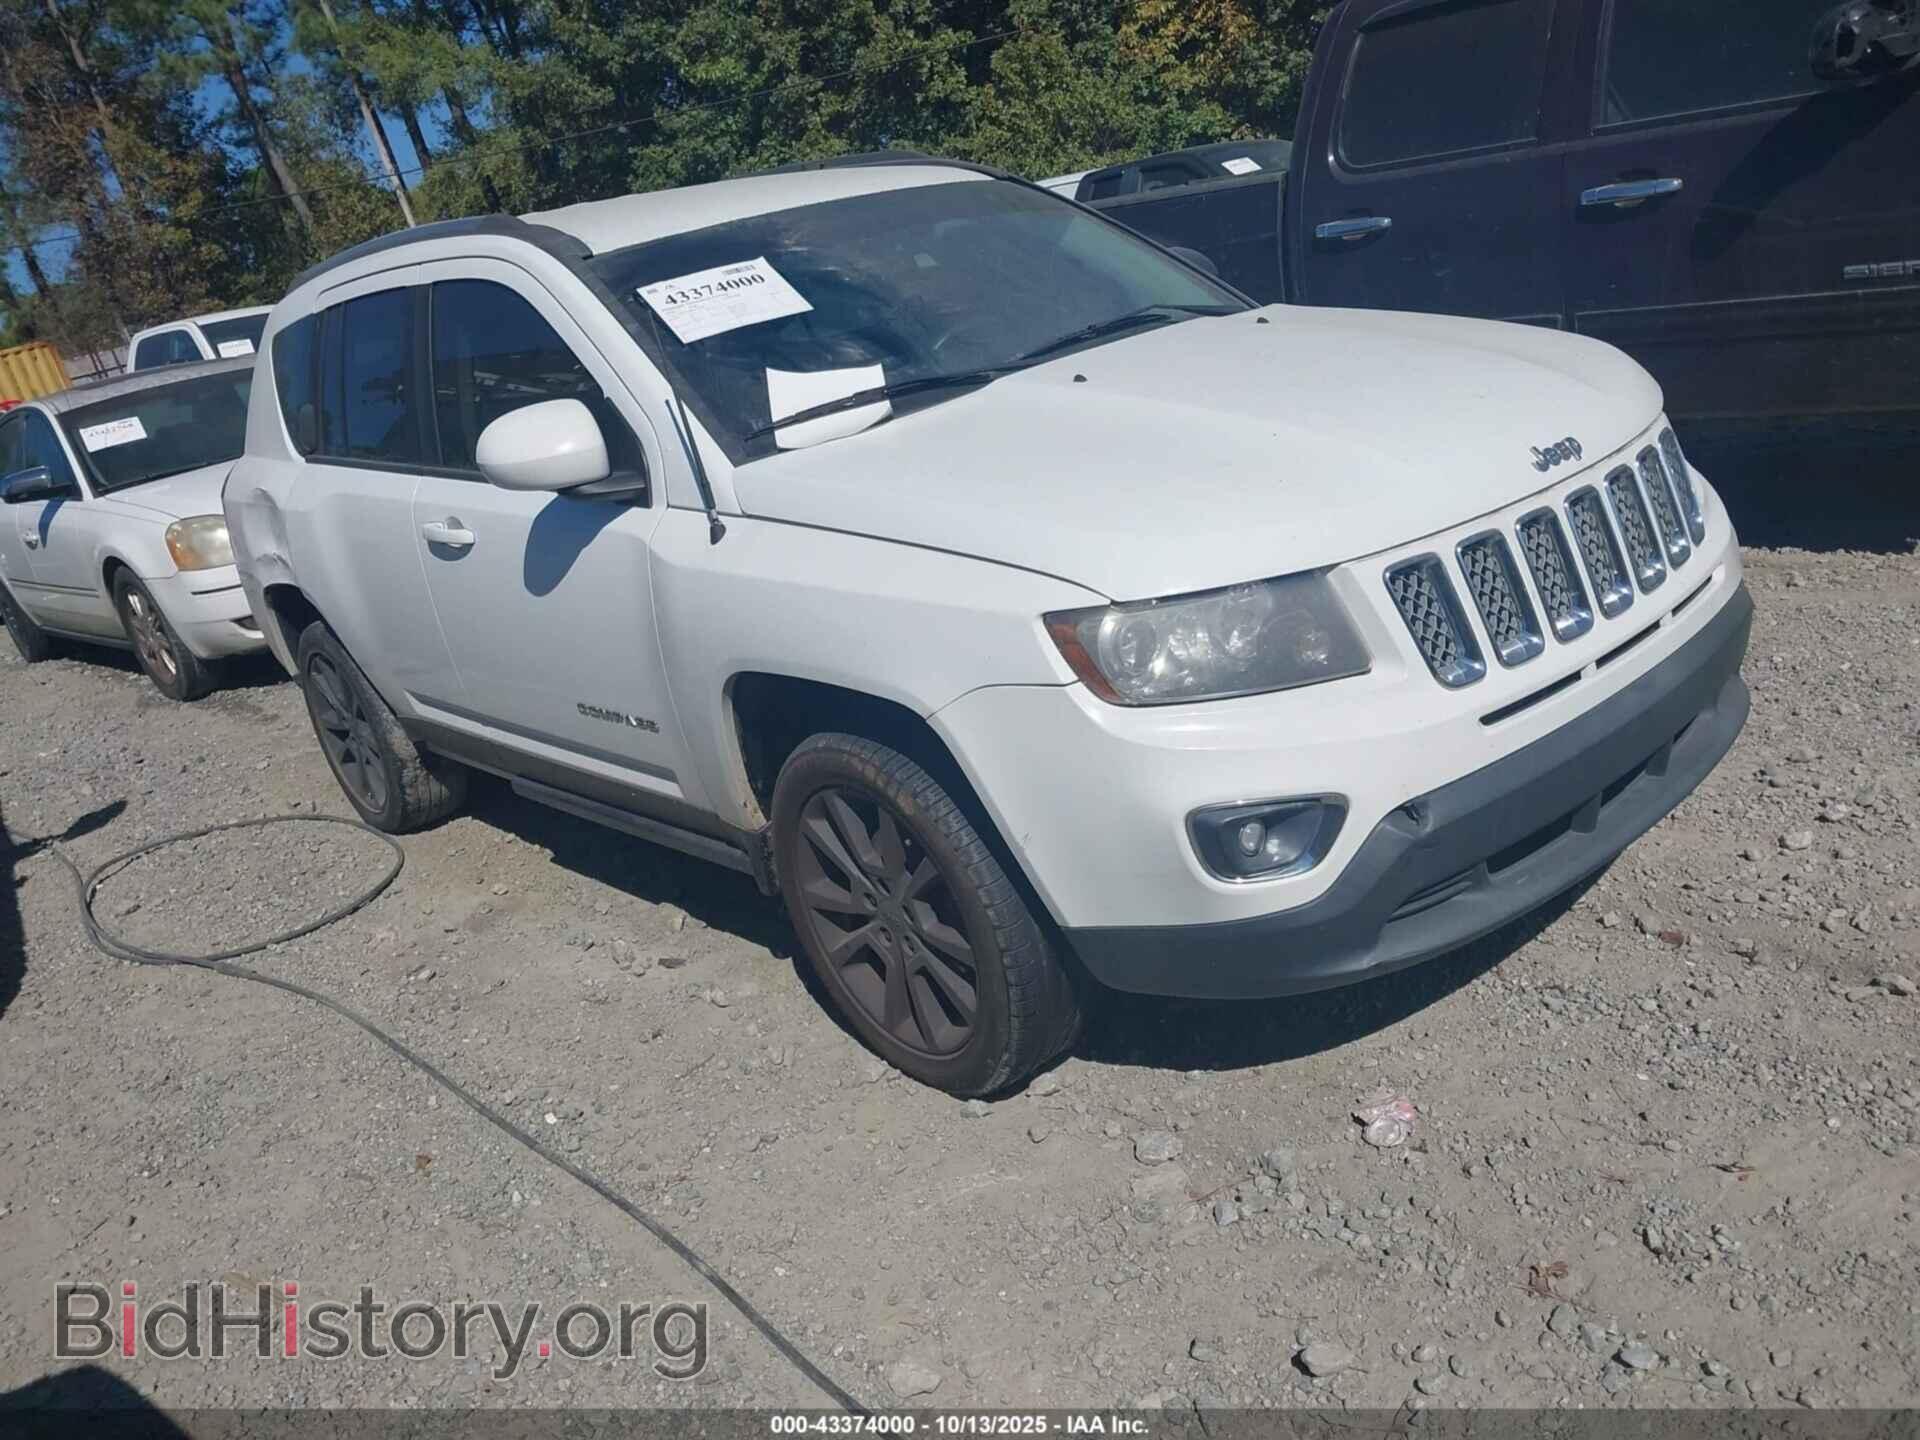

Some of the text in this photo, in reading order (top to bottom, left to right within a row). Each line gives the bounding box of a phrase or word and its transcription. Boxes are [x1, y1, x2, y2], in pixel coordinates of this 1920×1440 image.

[664, 273, 766, 306] 43374000
[1529, 437, 1582, 472] Jeep
[577, 703, 660, 733] COMPASS
